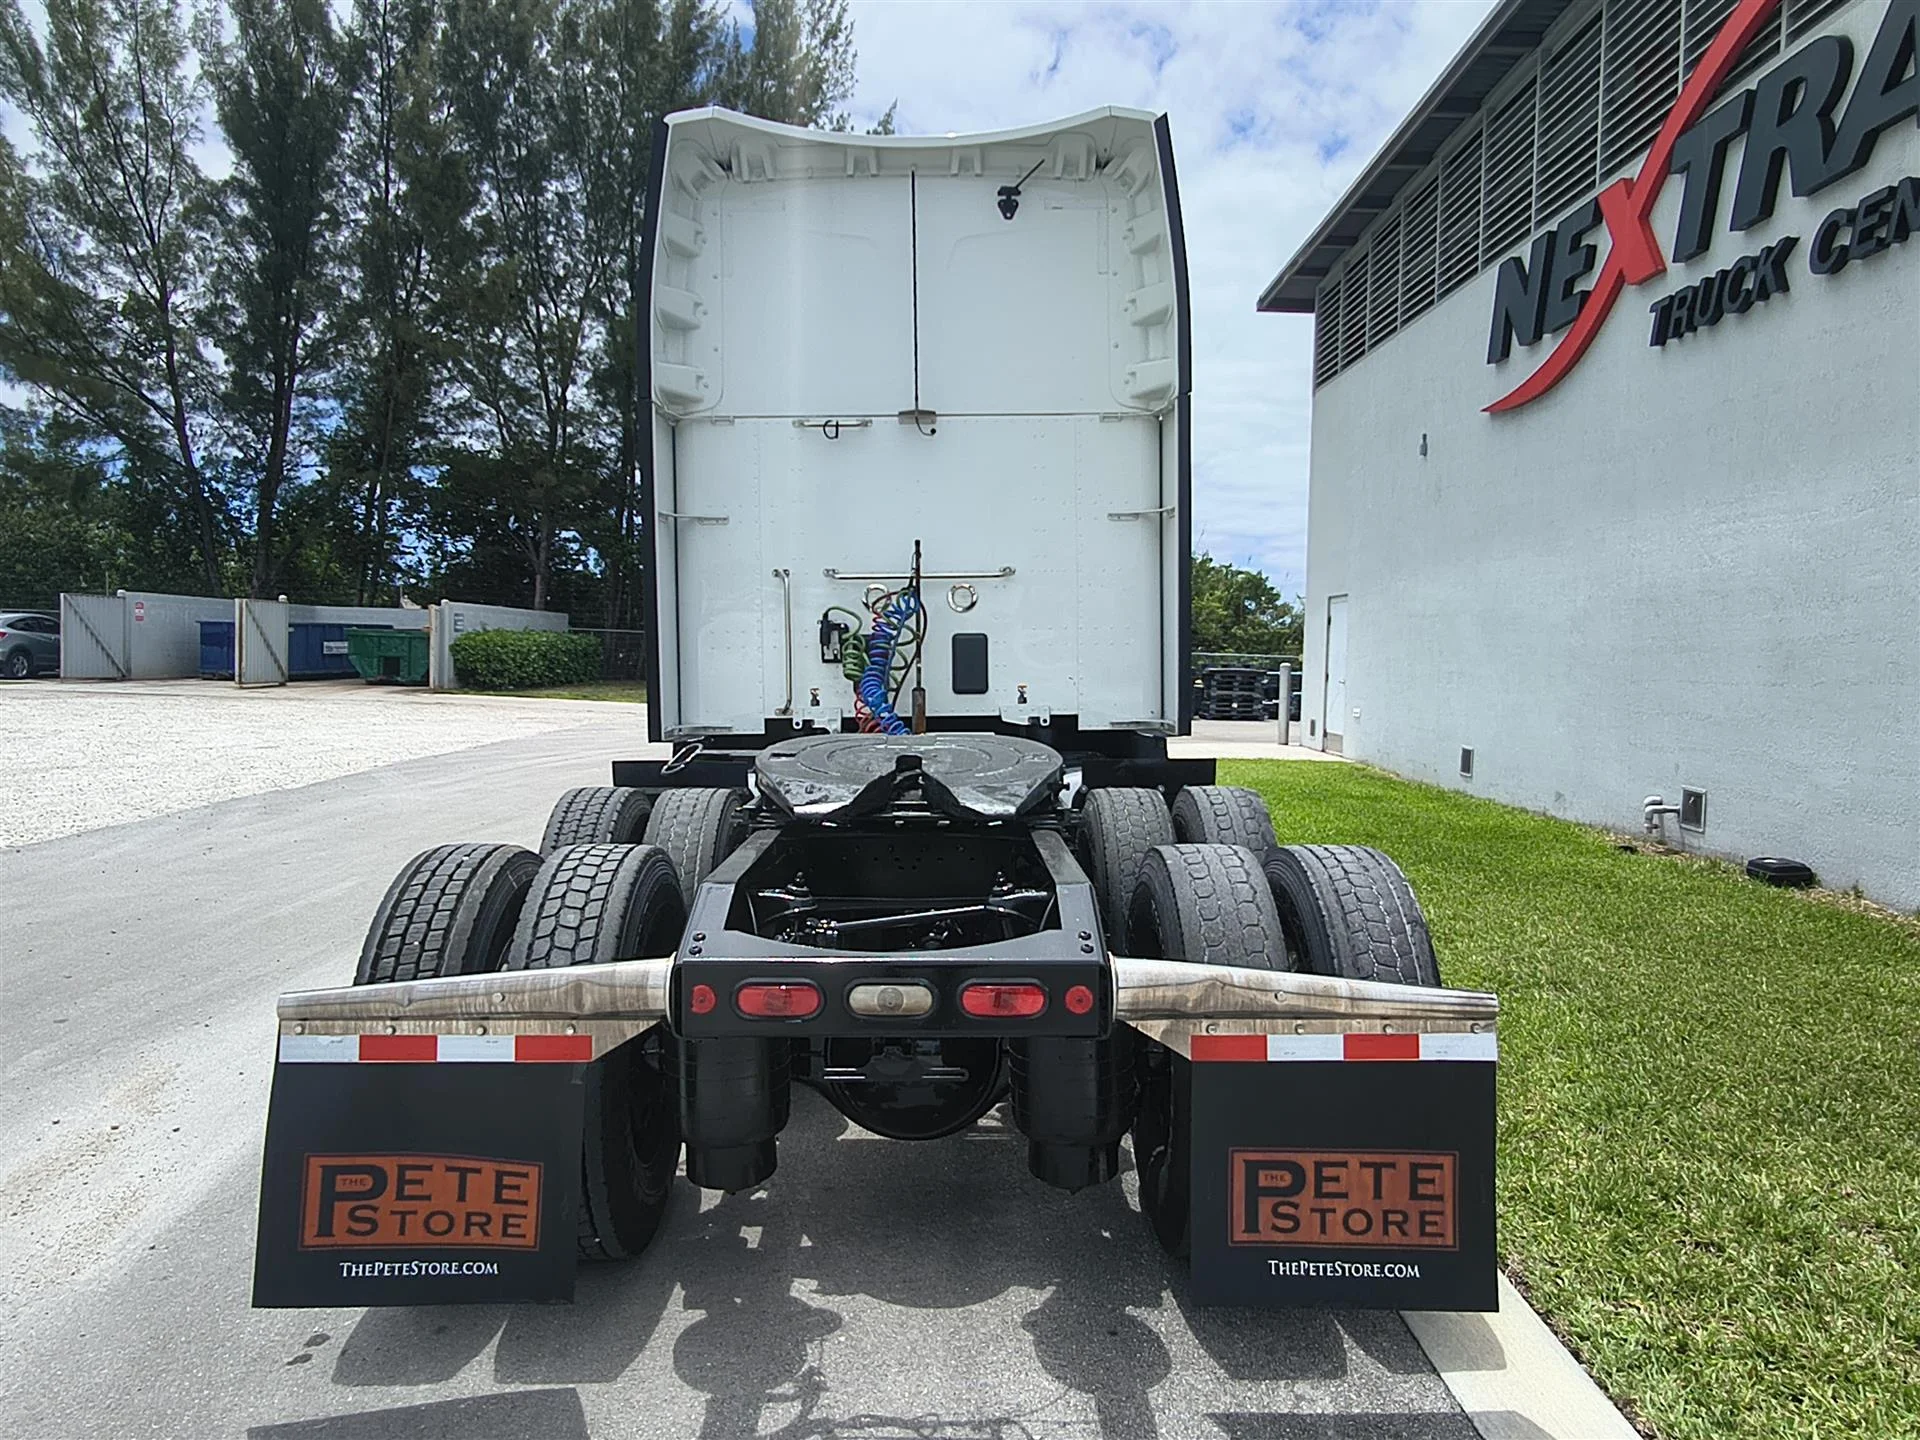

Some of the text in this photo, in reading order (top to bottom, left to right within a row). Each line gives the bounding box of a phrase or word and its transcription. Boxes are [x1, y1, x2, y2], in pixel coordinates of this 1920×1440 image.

[1649, 236, 1799, 347] TRUCK
[340, 1177, 367, 1187] THE
[1242, 1159, 1445, 1234] PETE
[1264, 1173, 1287, 1182] THE
[315, 1163, 530, 1239] PETE
[1271, 1201, 1445, 1239] STORE
[345, 1204, 527, 1239] STORE
